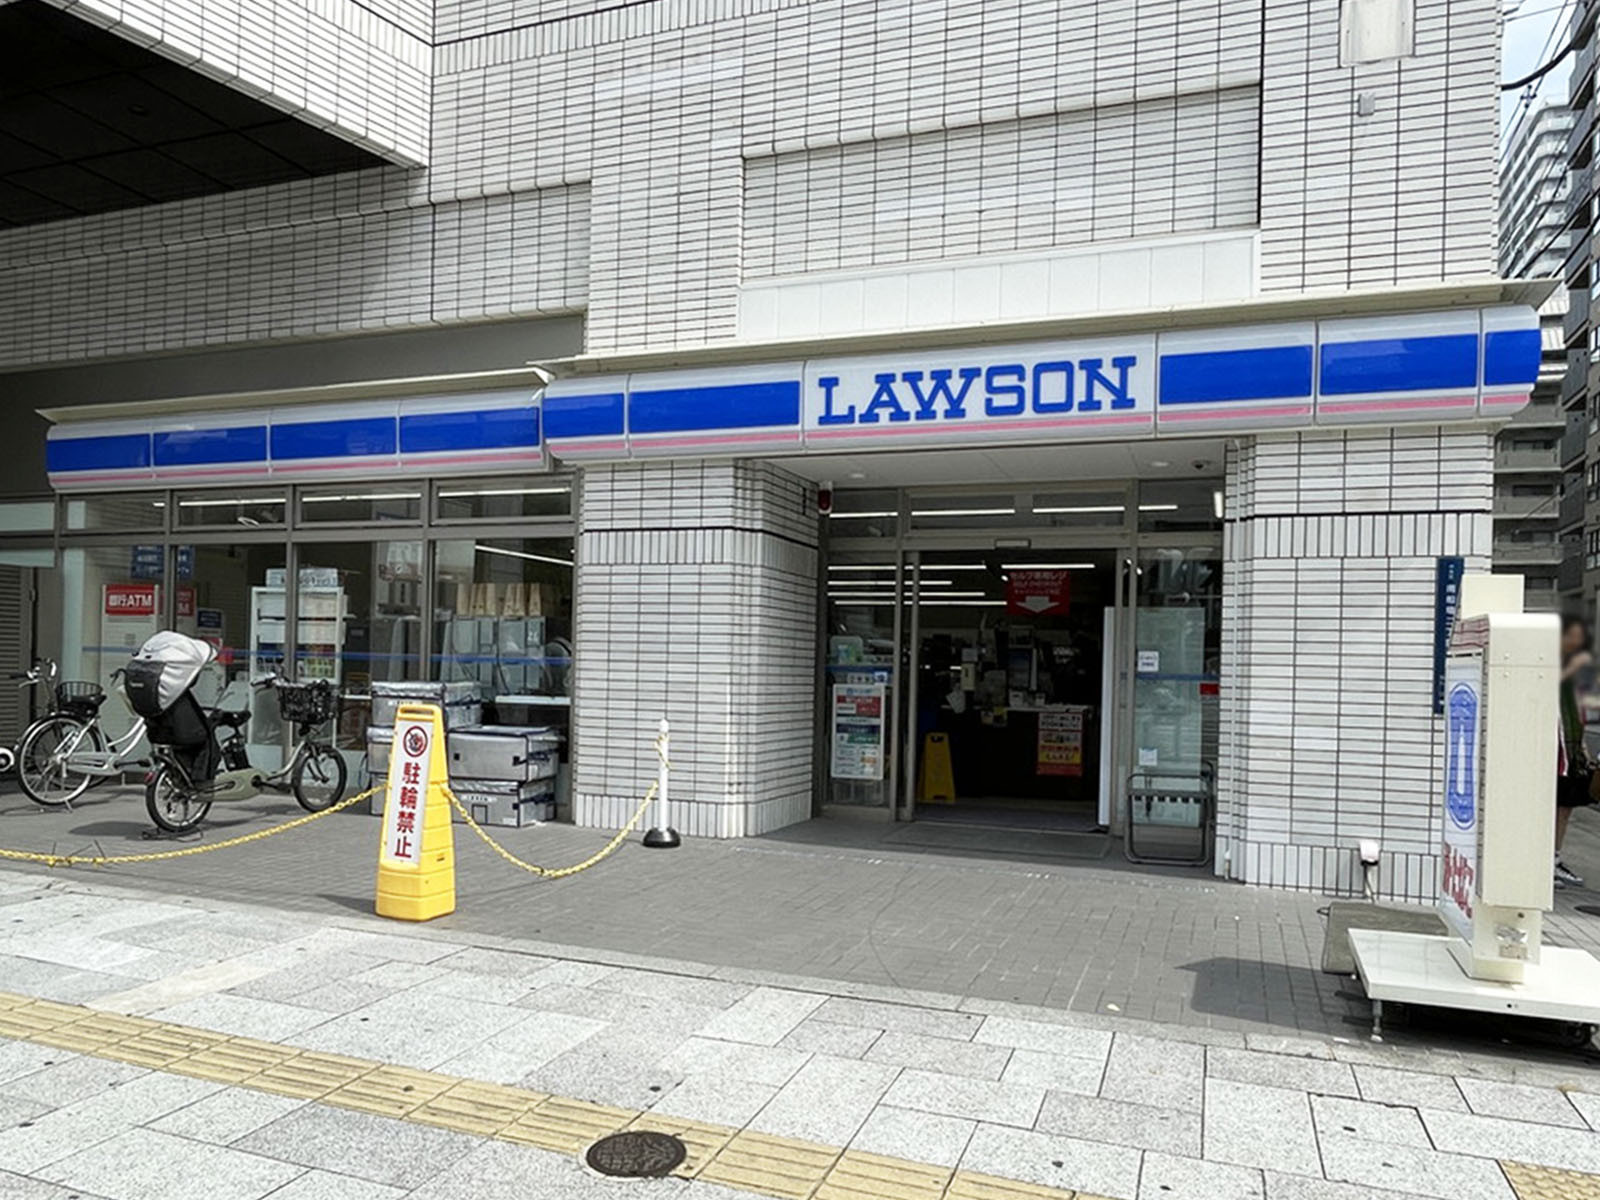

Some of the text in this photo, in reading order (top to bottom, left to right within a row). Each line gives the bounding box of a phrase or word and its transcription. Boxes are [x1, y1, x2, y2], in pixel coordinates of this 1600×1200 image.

[818, 356, 1137, 425] LAWSON
[394, 762, 421, 859] 駐輪禁止
